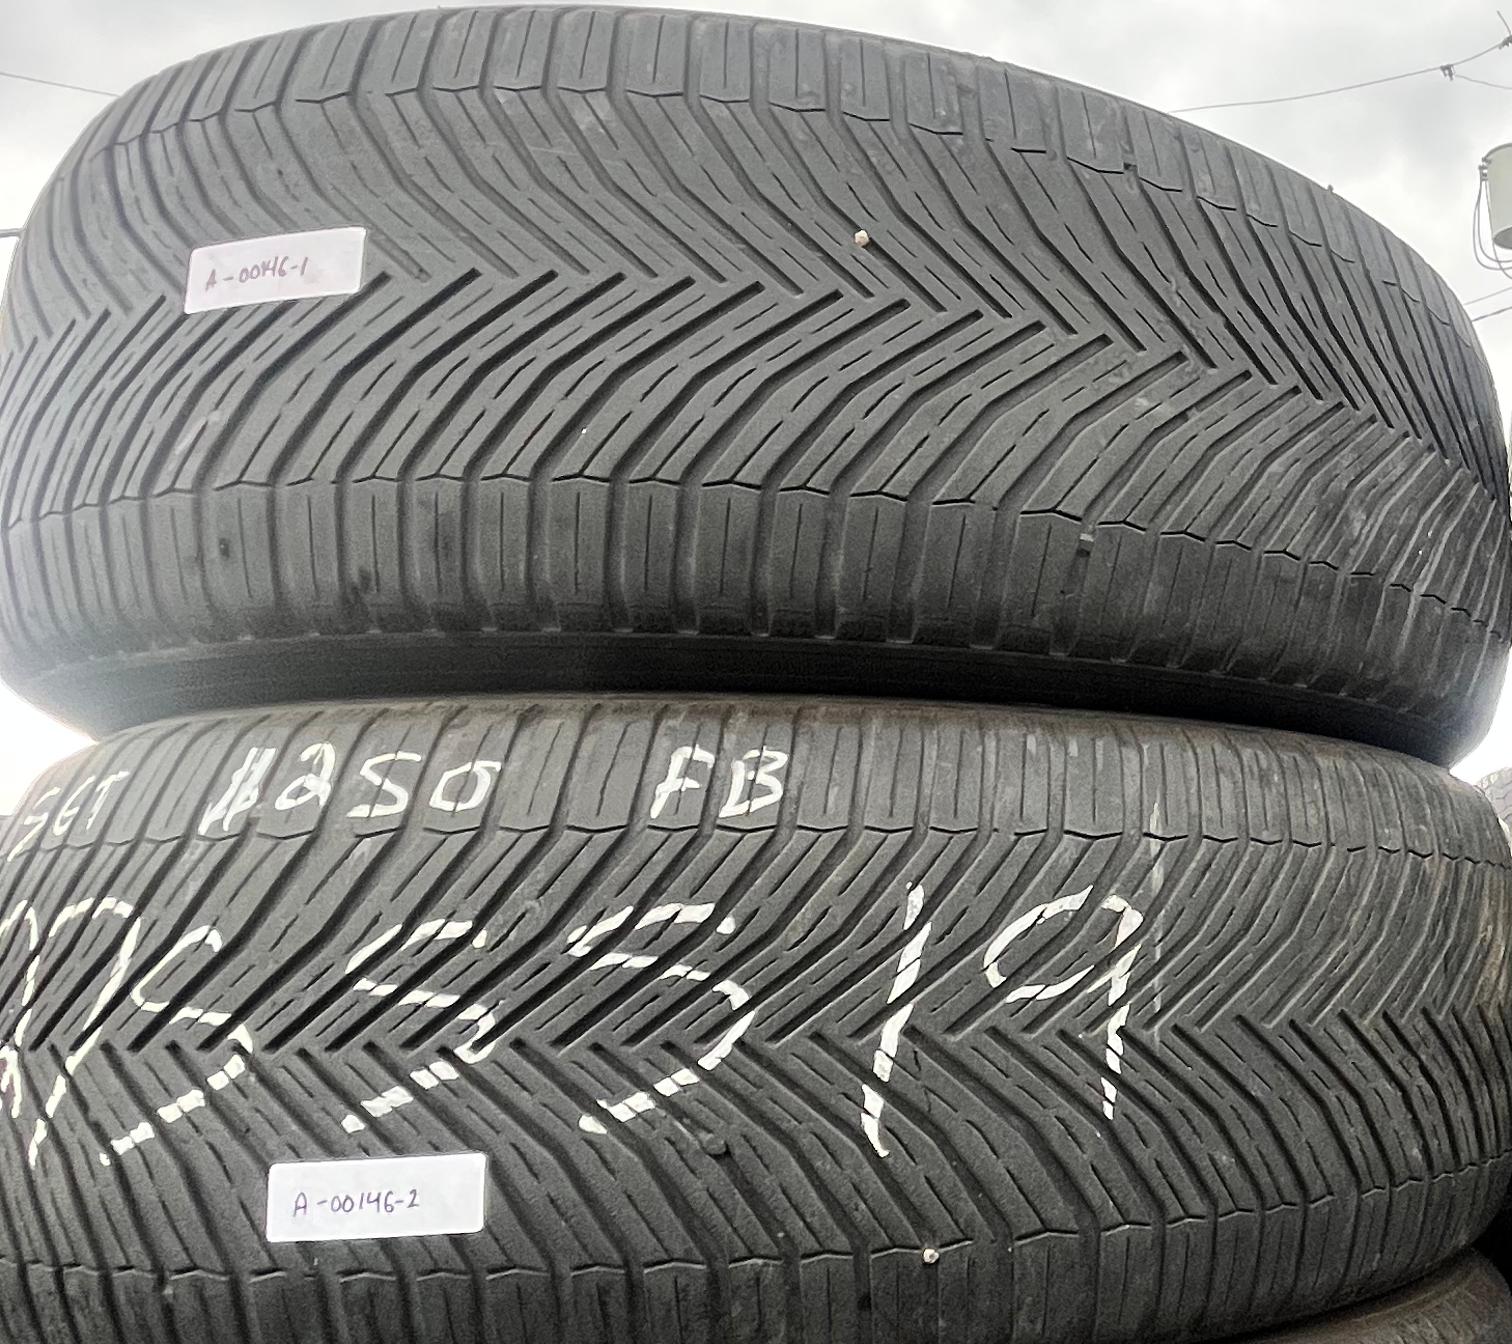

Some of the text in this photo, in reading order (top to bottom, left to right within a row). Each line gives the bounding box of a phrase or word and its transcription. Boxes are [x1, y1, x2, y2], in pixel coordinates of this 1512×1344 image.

[9, 770, 131, 862] SET
[650, 744, 790, 819] FB
[292, 1188, 421, 1218] A-00146-2
